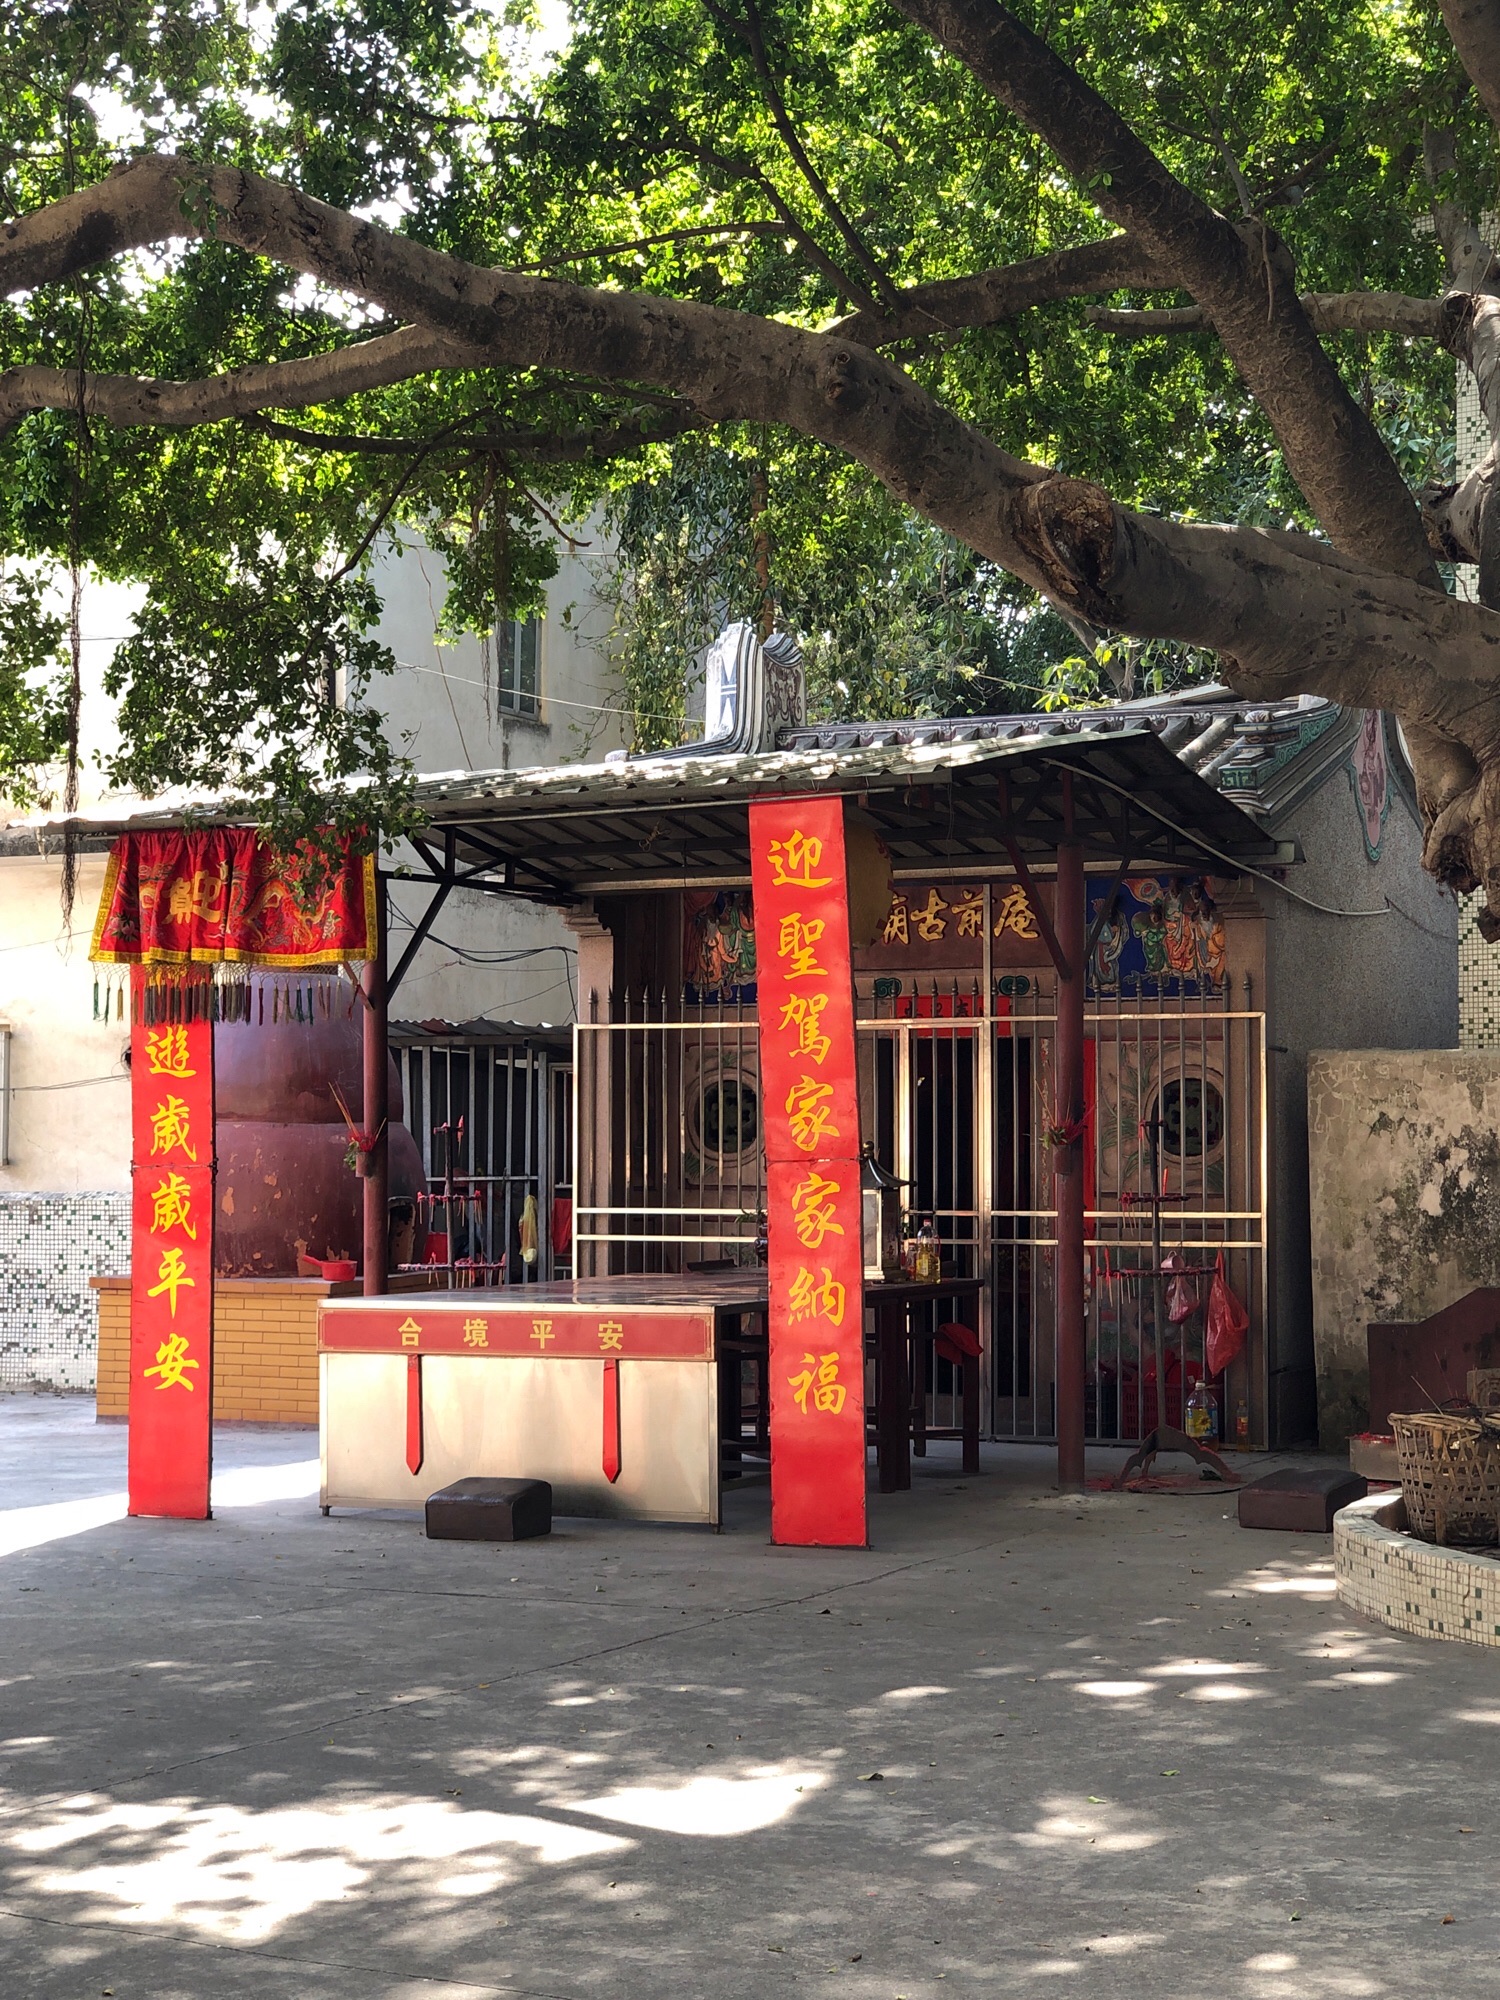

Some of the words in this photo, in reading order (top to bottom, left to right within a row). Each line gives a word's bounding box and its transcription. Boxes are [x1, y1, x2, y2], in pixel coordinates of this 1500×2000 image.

[144, 966, 200, 1392] 遊歲歲平安
[397, 1316, 625, 1351] 合境平安
[767, 829, 847, 1415] 迎聖駕家家納福
